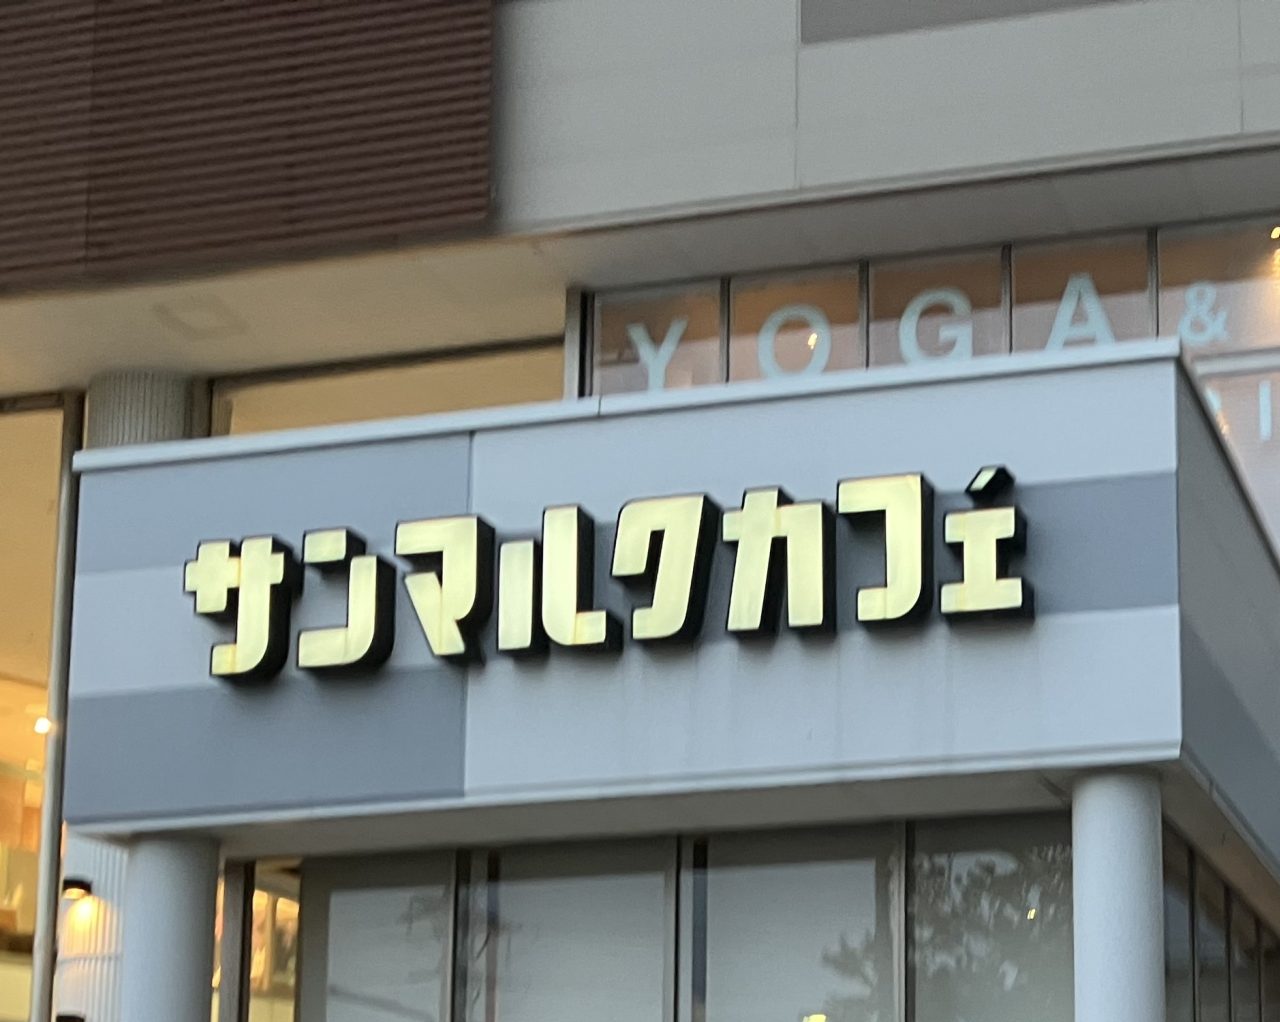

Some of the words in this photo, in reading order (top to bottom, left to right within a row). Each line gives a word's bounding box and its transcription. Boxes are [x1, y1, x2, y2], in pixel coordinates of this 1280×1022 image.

[626, 273, 1116, 390] YOGA
[184, 465, 1026, 676] サンマルクカフェ
